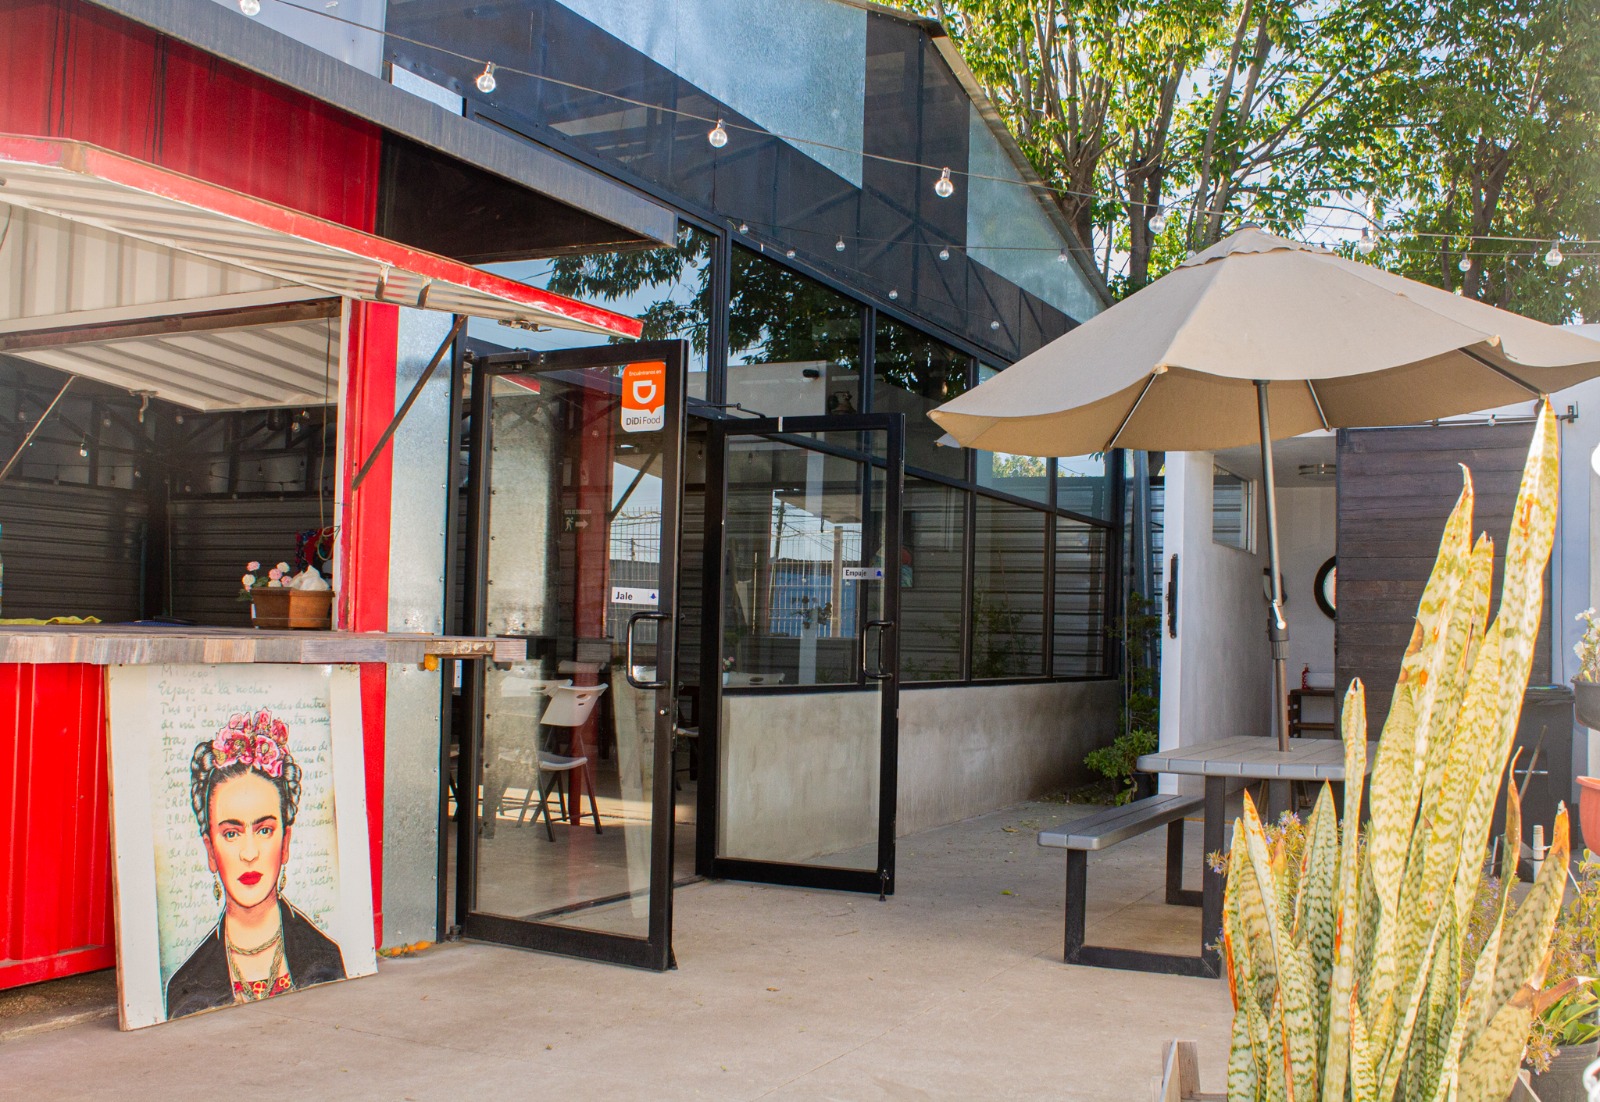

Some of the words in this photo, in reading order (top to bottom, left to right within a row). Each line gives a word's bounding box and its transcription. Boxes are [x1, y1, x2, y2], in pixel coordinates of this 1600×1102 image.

[626, 417, 642, 426] DiDi
[642, 416, 661, 425] Food
[845, 569, 867, 578] Empuje
[615, 591, 633, 601] Jale
